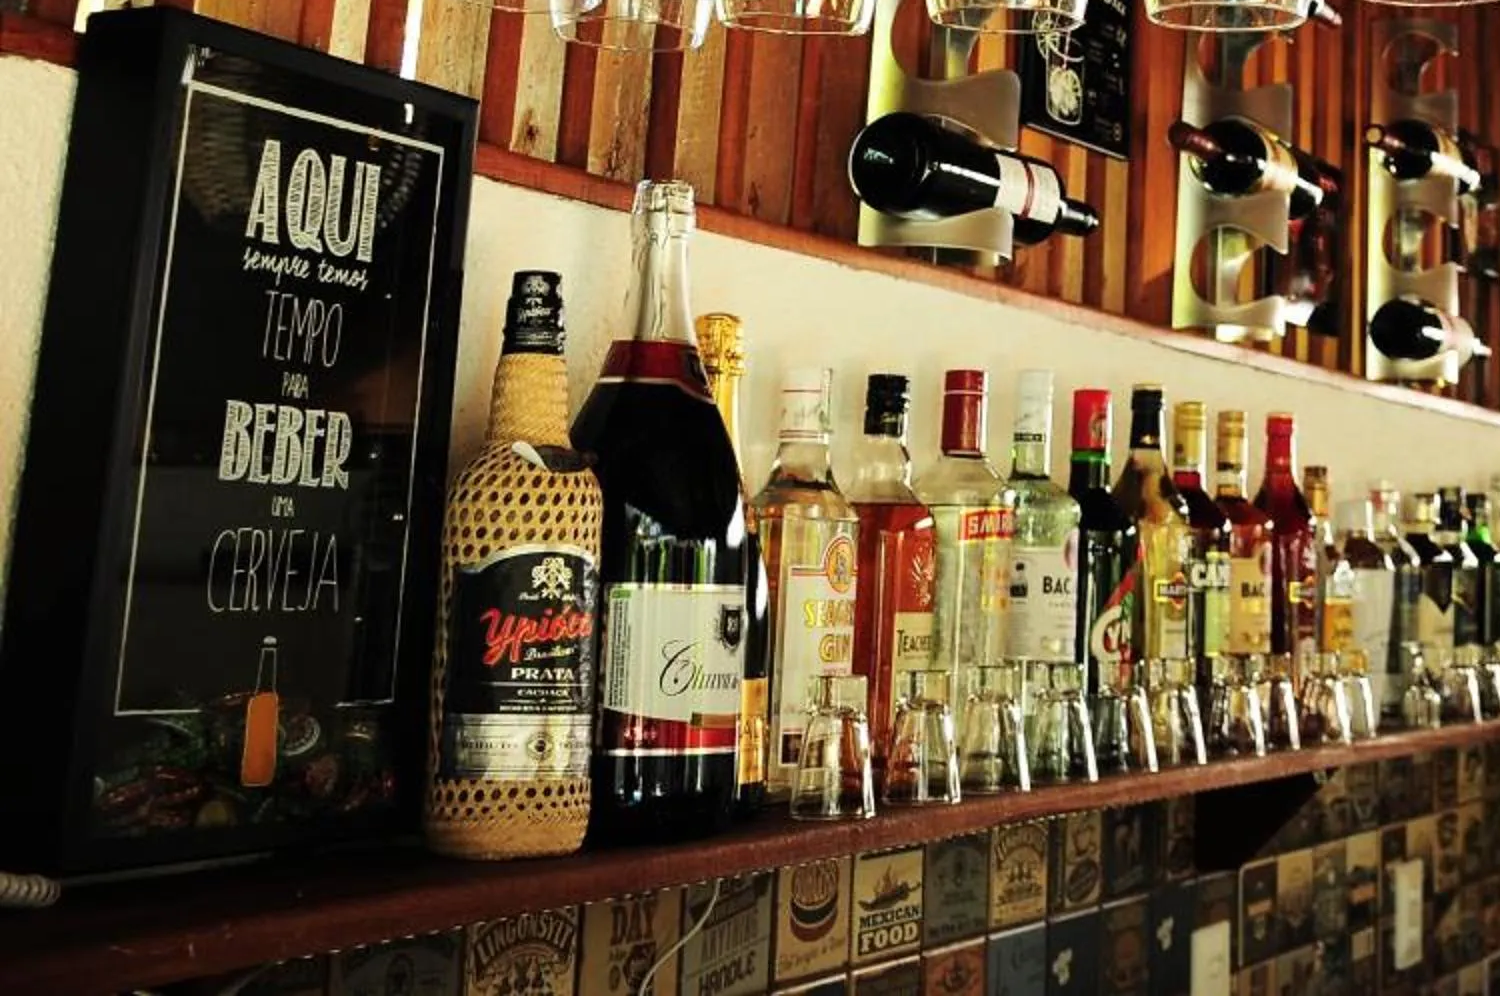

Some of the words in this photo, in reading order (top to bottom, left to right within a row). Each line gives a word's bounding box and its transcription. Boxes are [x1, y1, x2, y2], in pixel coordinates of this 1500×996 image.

[245, 139, 381, 263] AQUI
[243, 247, 310, 286] sempre
[318, 258, 369, 291] temos
[262, 289, 343, 368] TEMPO
[281, 371, 310, 400] PARA
[218, 399, 353, 490] BEBER
[271, 495, 295, 518] UMA
[207, 527, 339, 613] CERVEJA
[511, 667, 575, 682] PRATA
[859, 905, 920, 929] MEXICAN
[860, 921, 919, 953] FOOD
